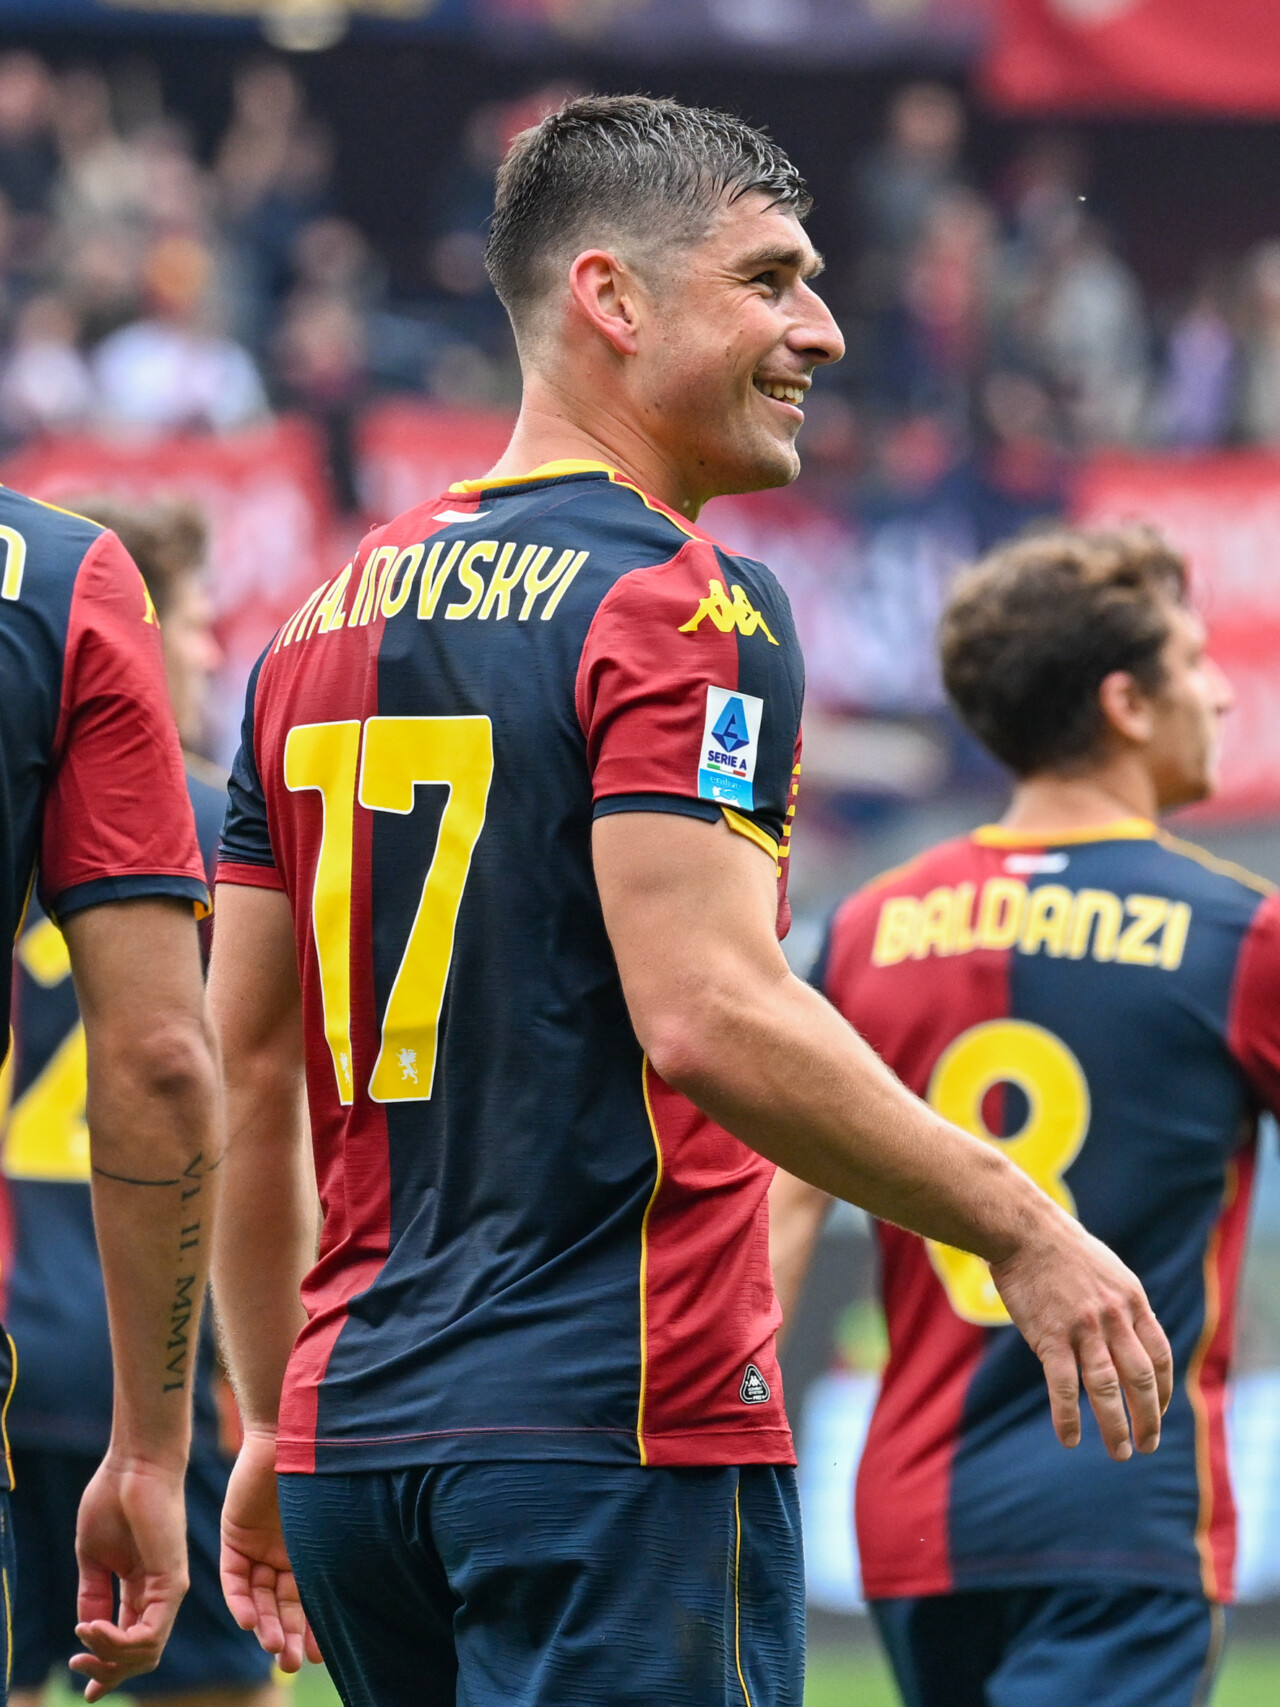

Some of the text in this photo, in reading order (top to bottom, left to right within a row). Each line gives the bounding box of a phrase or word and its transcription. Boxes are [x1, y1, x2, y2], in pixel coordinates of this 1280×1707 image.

[707, 750, 747, 770] SERIE A
[284, 715, 494, 1106] 17
[872, 878, 1192, 969] BALDANZI
[925, 1018, 1091, 1327] 8
